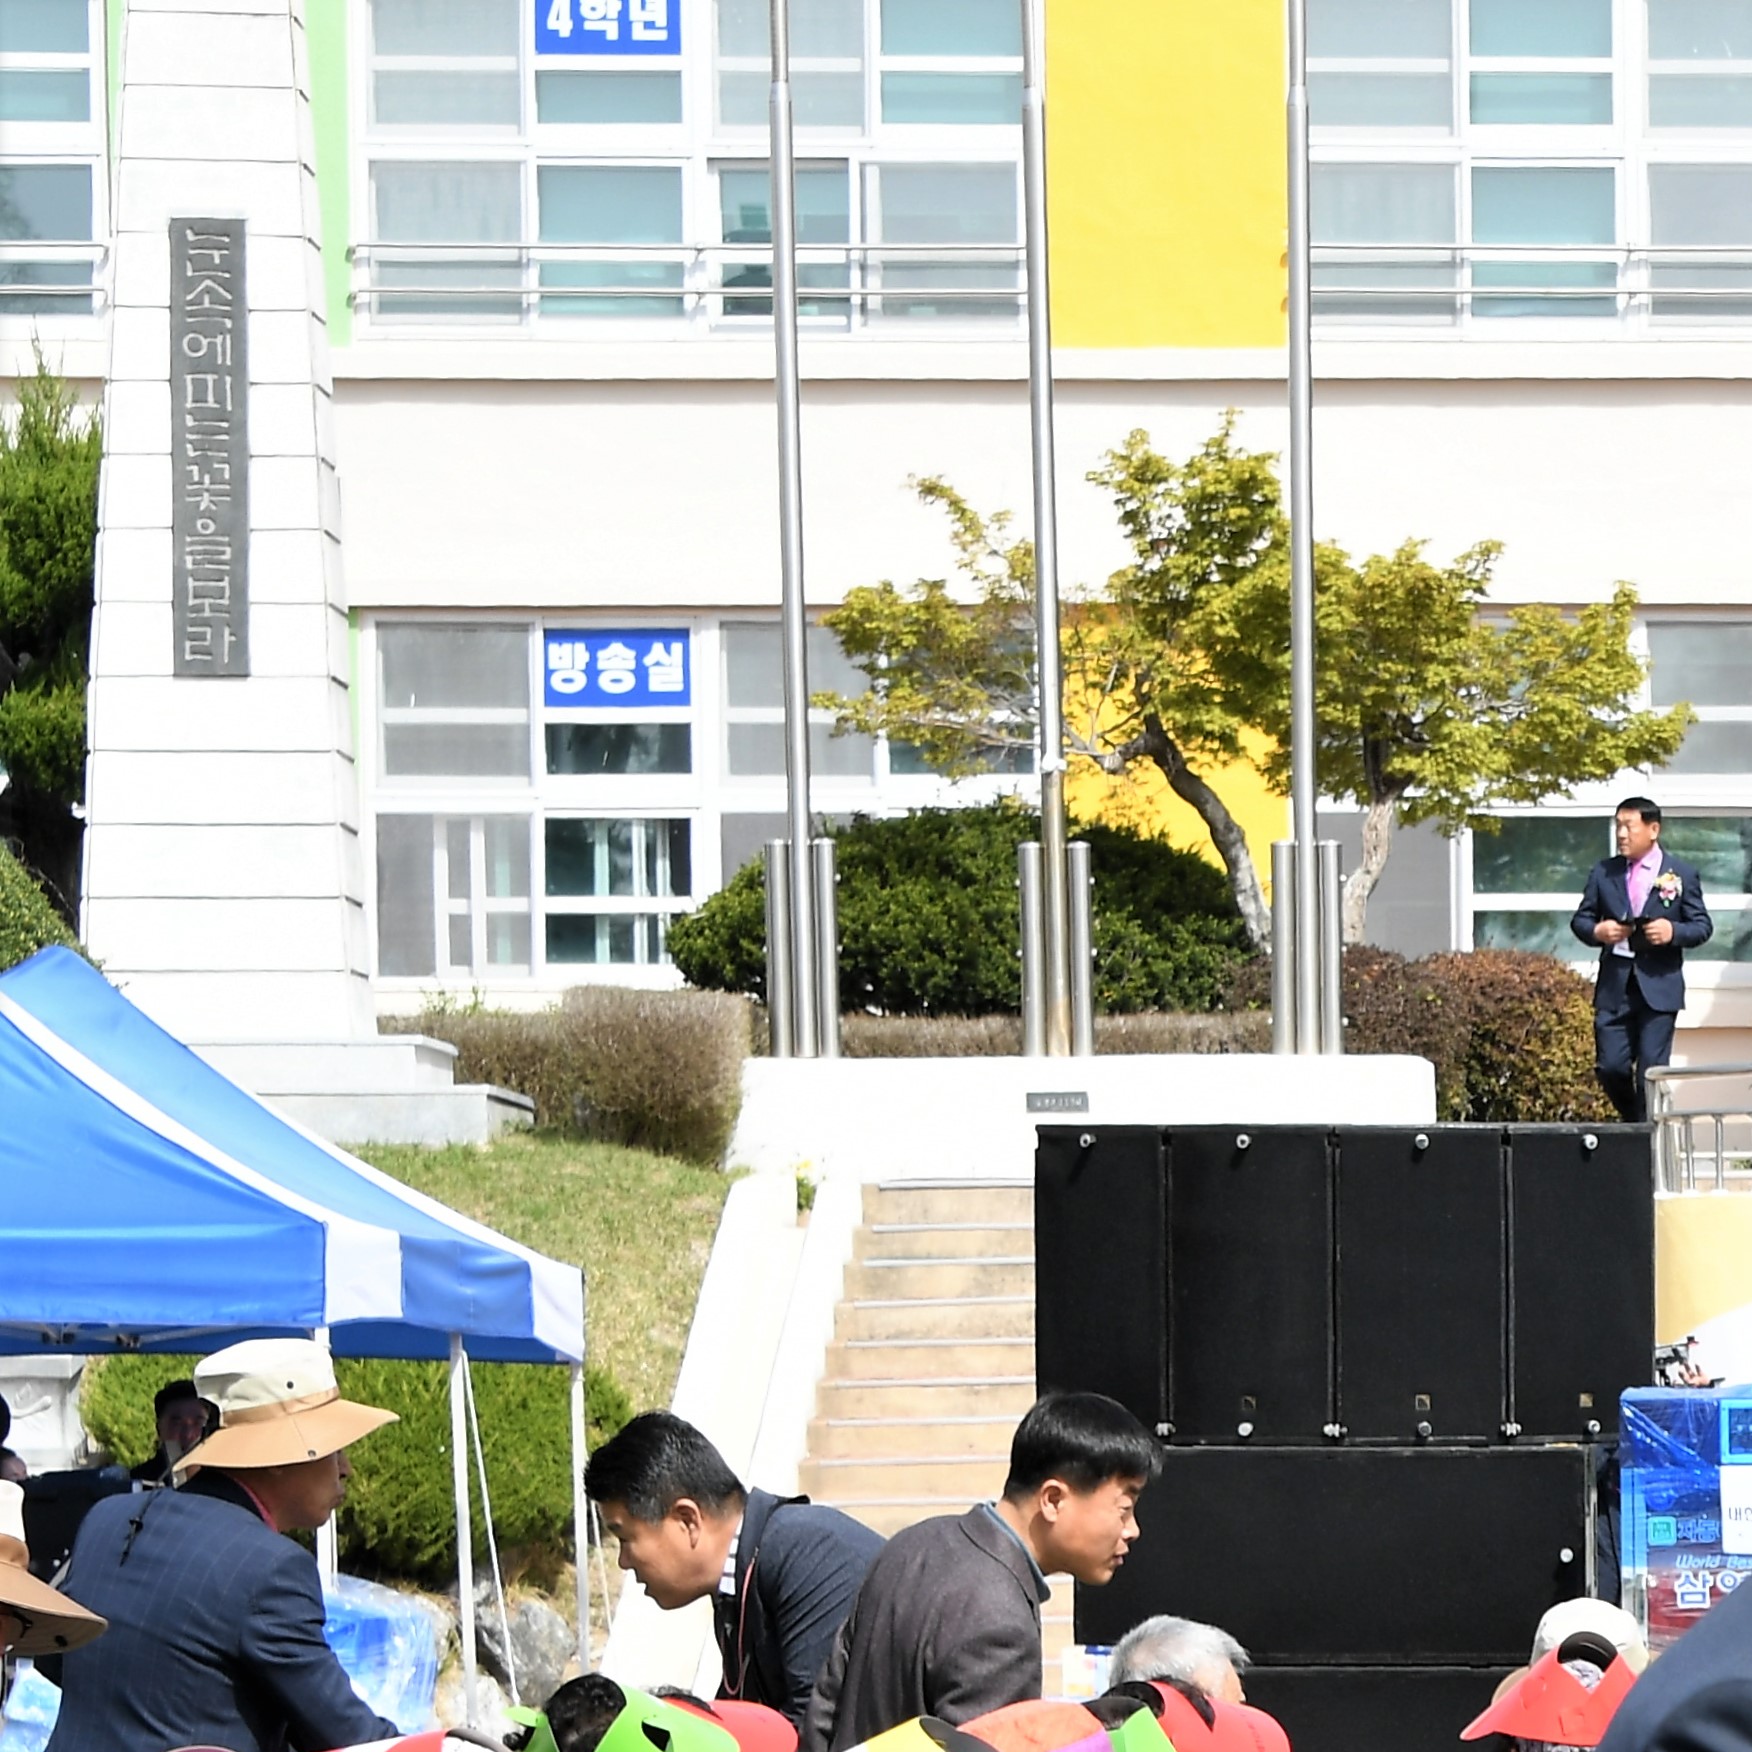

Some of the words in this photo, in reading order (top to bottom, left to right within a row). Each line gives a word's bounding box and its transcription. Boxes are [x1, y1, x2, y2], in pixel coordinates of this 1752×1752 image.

[547, 0, 668, 41] 4학년
[548, 642, 684, 694] 방송실
[1676, 1554, 1721, 1569] World
